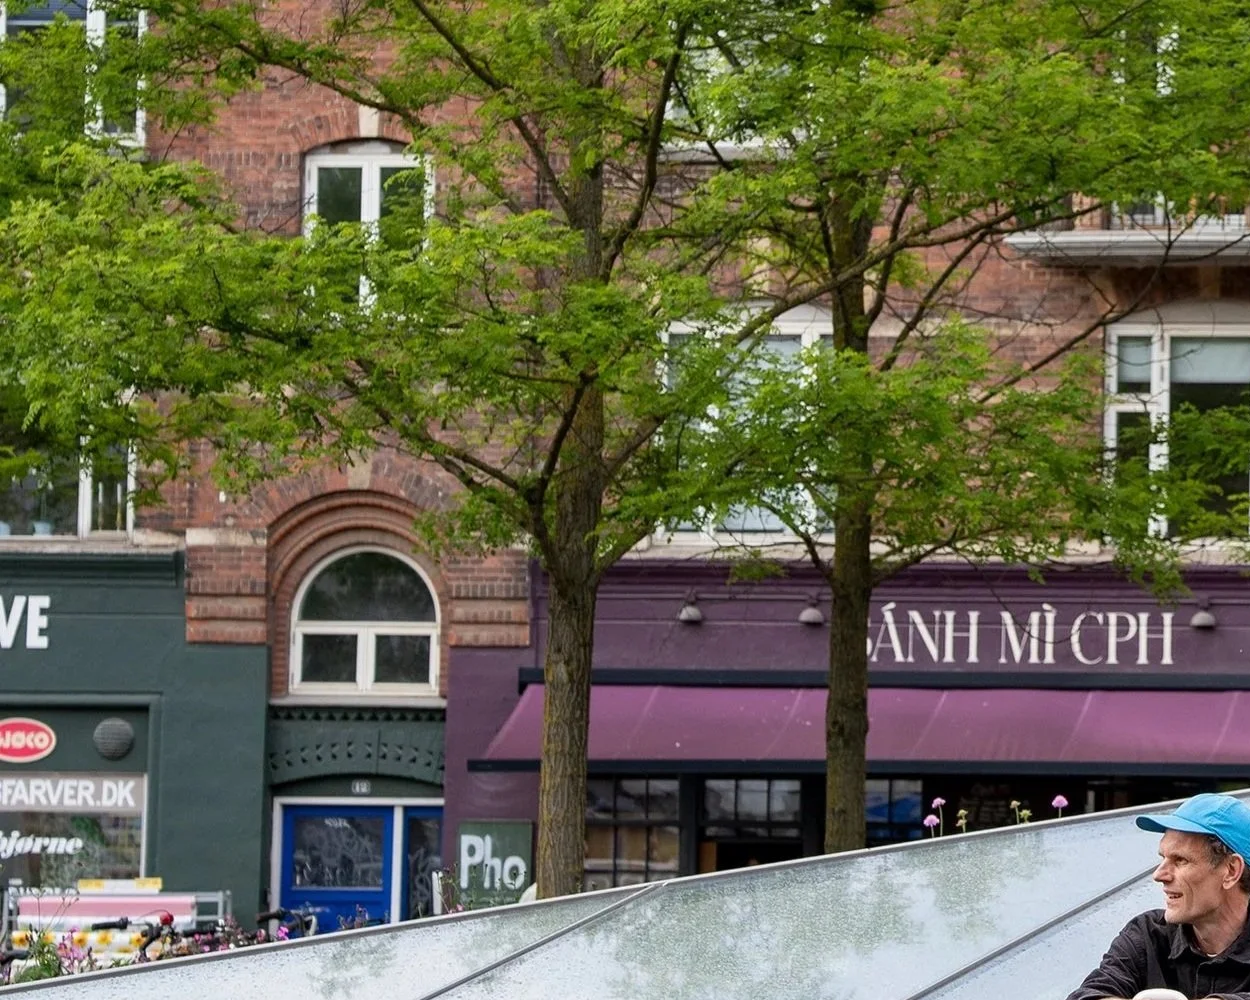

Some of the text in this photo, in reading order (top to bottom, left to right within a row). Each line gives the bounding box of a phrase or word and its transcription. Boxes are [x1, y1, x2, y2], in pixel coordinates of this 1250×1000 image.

[866, 602, 1174, 666] ÁNH MÌ CPH
[0, 779, 136, 807] FARVER.DK
[460, 834, 527, 890] Pho
